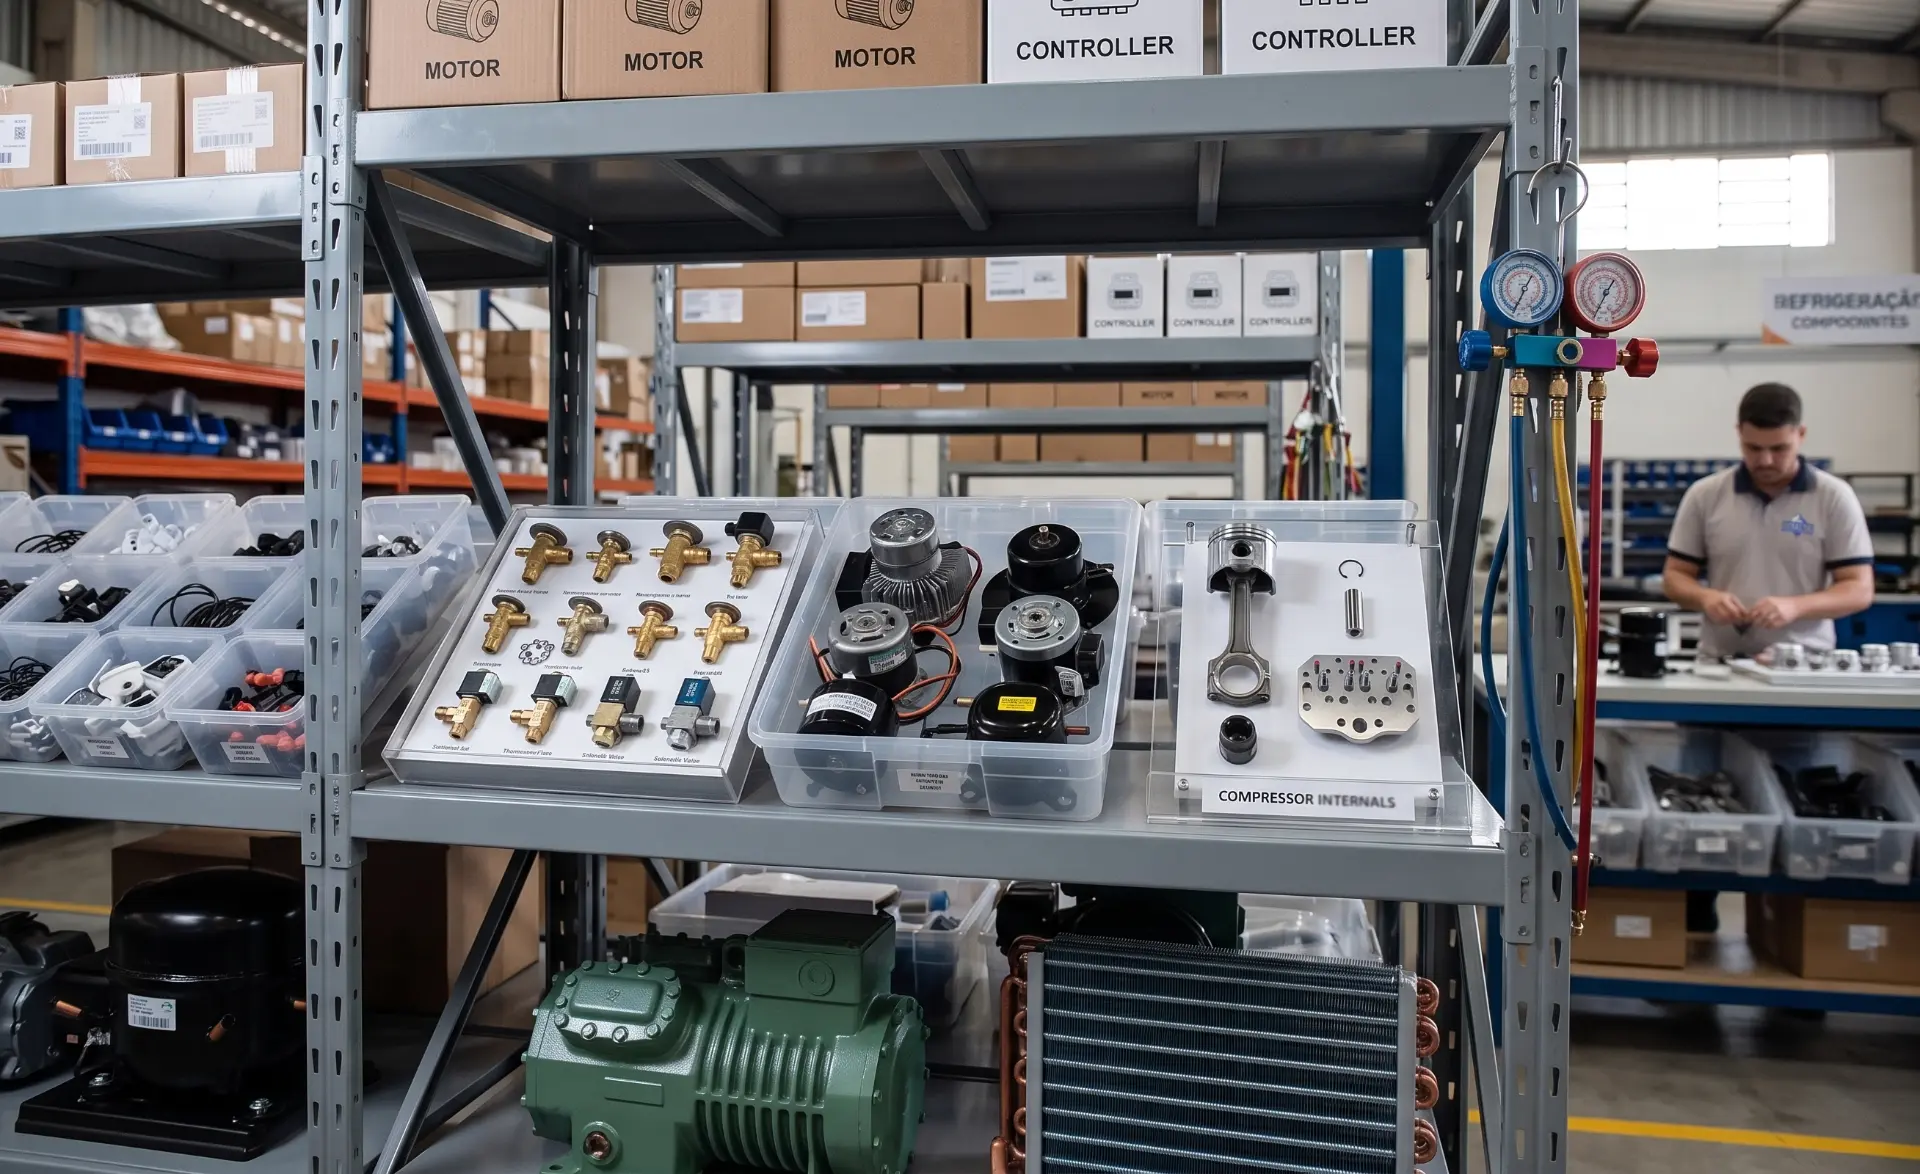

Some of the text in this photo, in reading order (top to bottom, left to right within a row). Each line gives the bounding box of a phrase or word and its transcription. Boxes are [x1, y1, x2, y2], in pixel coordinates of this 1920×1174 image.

[1016, 35, 1174, 61] CONTROLLER
[1252, 25, 1416, 51] CONTROLLER
[624, 50, 704, 72] MOTOR
[834, 46, 917, 68] MOTOR
[425, 59, 501, 80] MOTOR
[1094, 318, 1155, 328] CONTROLLER
[1173, 317, 1236, 328] CONTROLLER
[1249, 316, 1313, 327] CONTROLLER
[1218, 790, 1397, 809] COMPRESSOR INTERNALS
